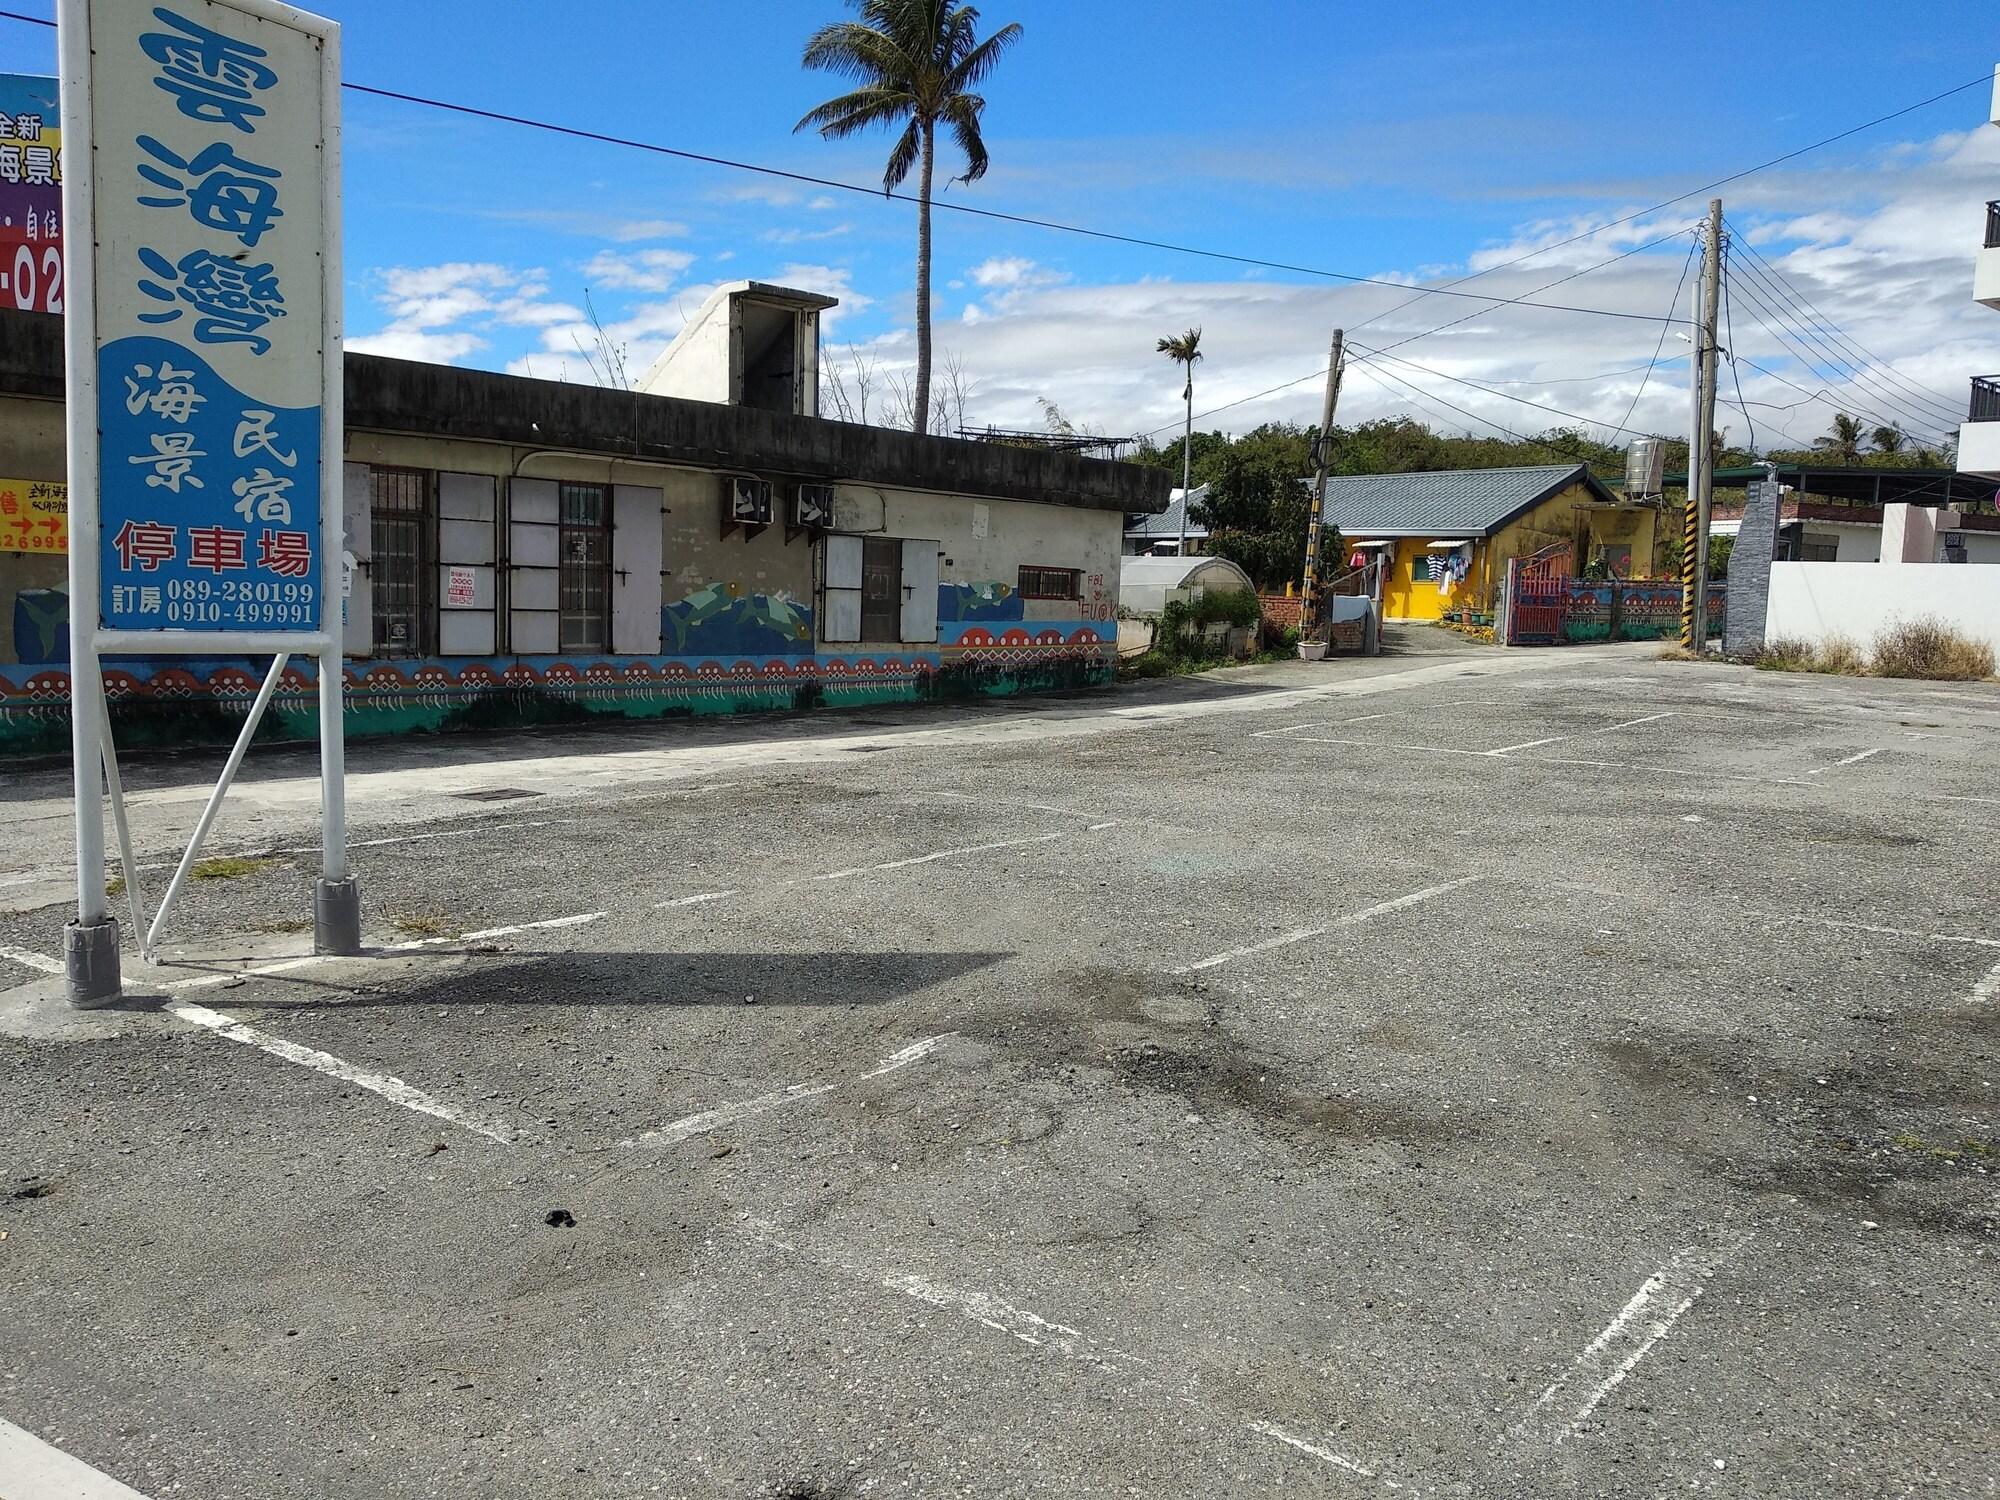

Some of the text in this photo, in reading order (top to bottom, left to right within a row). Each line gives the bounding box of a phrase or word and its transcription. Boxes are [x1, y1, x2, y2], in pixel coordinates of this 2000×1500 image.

[0, 112, 42, 141] 全新
[0, 145, 63, 186] 海景
[136, 7, 288, 356] 雲海灣
[124, 361, 208, 493] 海景
[232, 409, 298, 525] 民宿
[112, 519, 312, 578] 停車場
[167, 579, 314, 603] 089-280199
[1087, 573, 1104, 586] FBI
[112, 585, 162, 613] 訂房
[167, 601, 313, 623] 0910-499991
